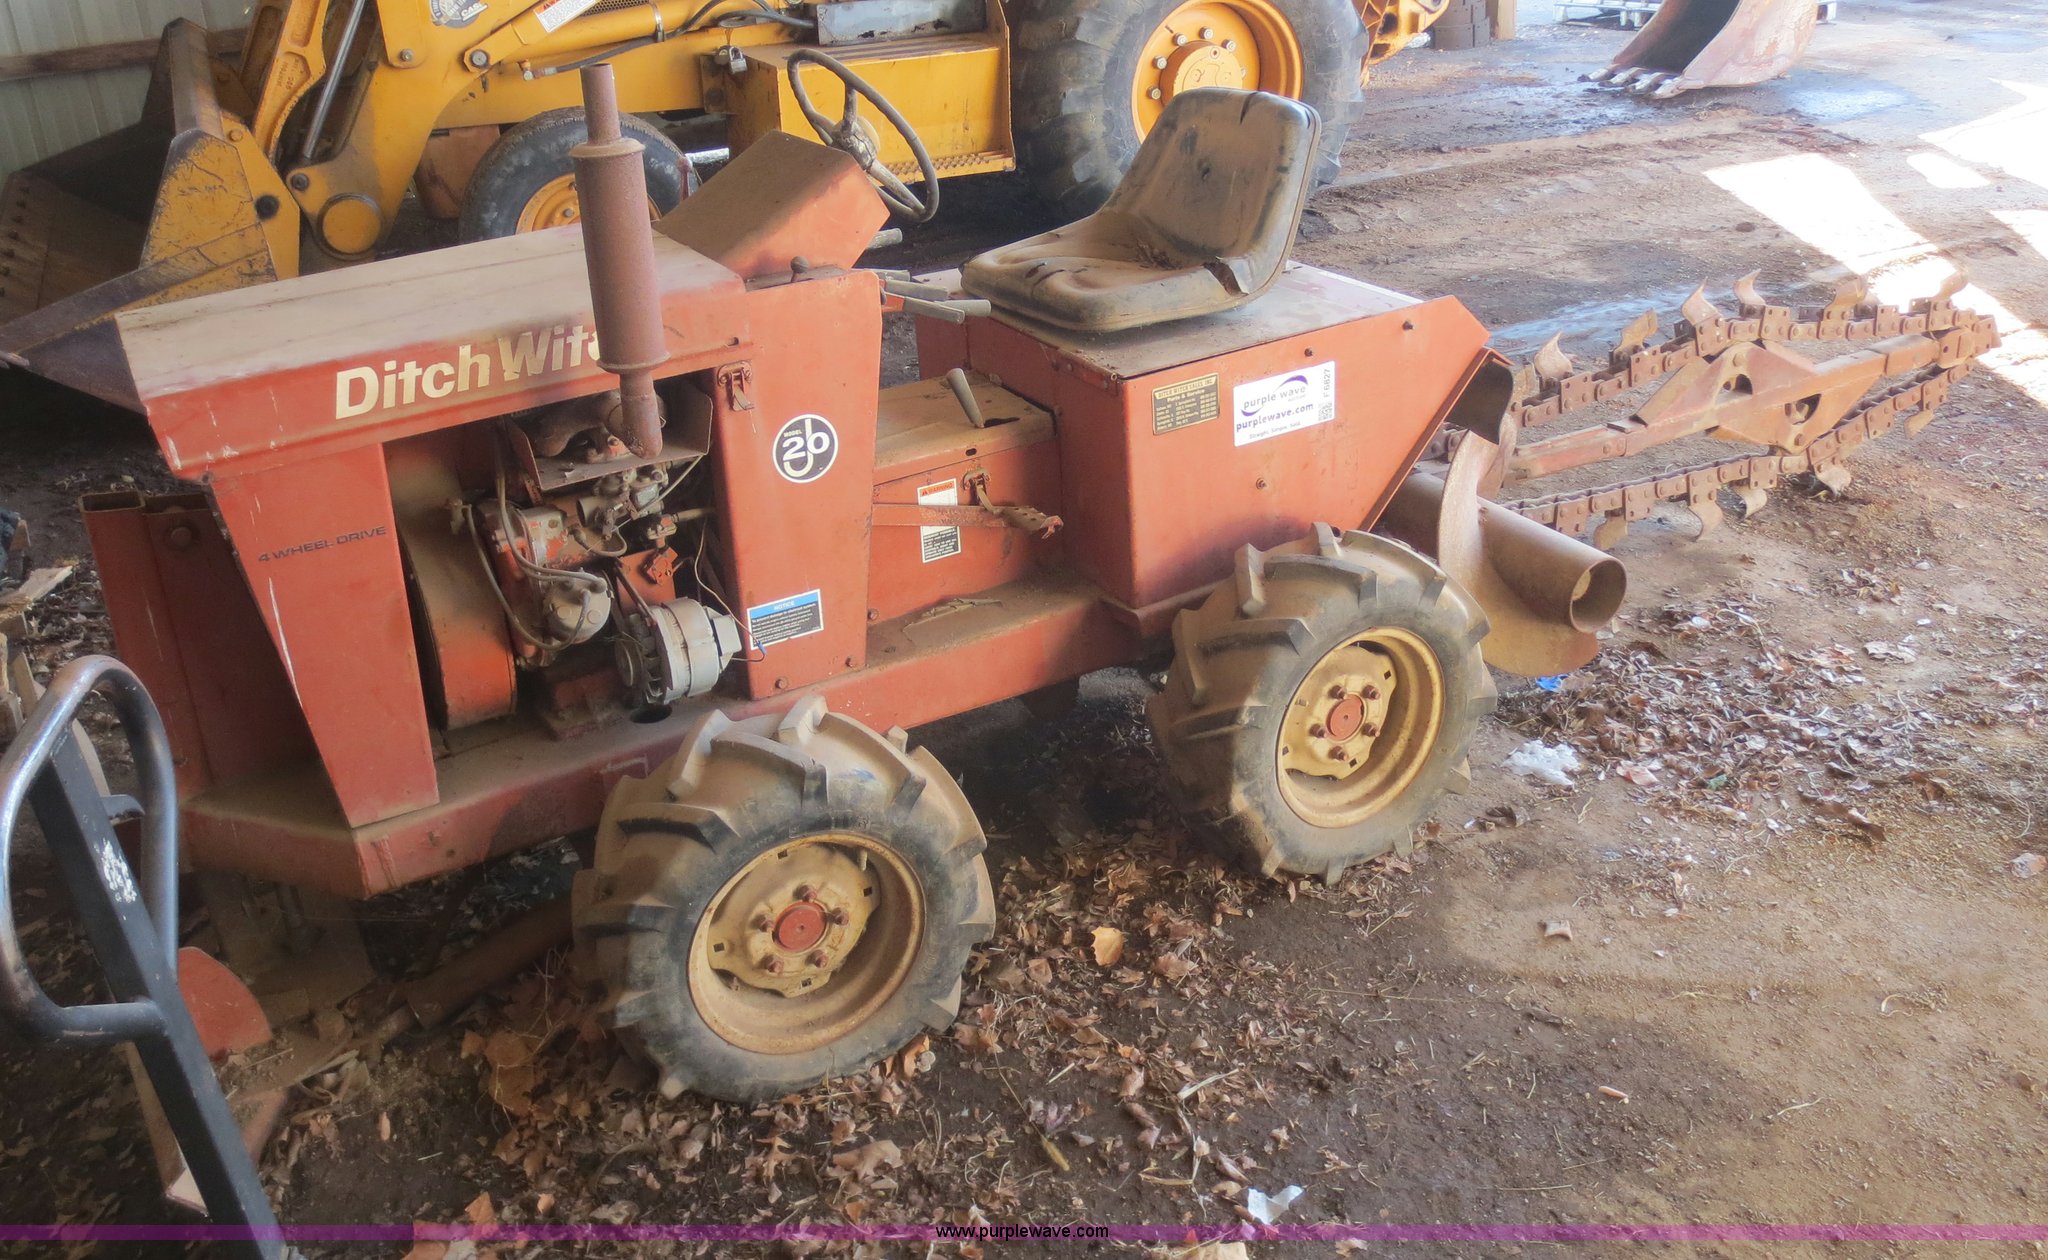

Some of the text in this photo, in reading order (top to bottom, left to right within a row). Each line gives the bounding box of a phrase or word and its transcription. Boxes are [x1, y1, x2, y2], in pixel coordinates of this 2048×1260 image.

[335, 344, 491, 420] Ditch
[1243, 385, 1306, 411] purple wave
[1236, 403, 1314, 432] purplewave.com
[258, 526, 387, 562] 4 WHEEL DRIVE
